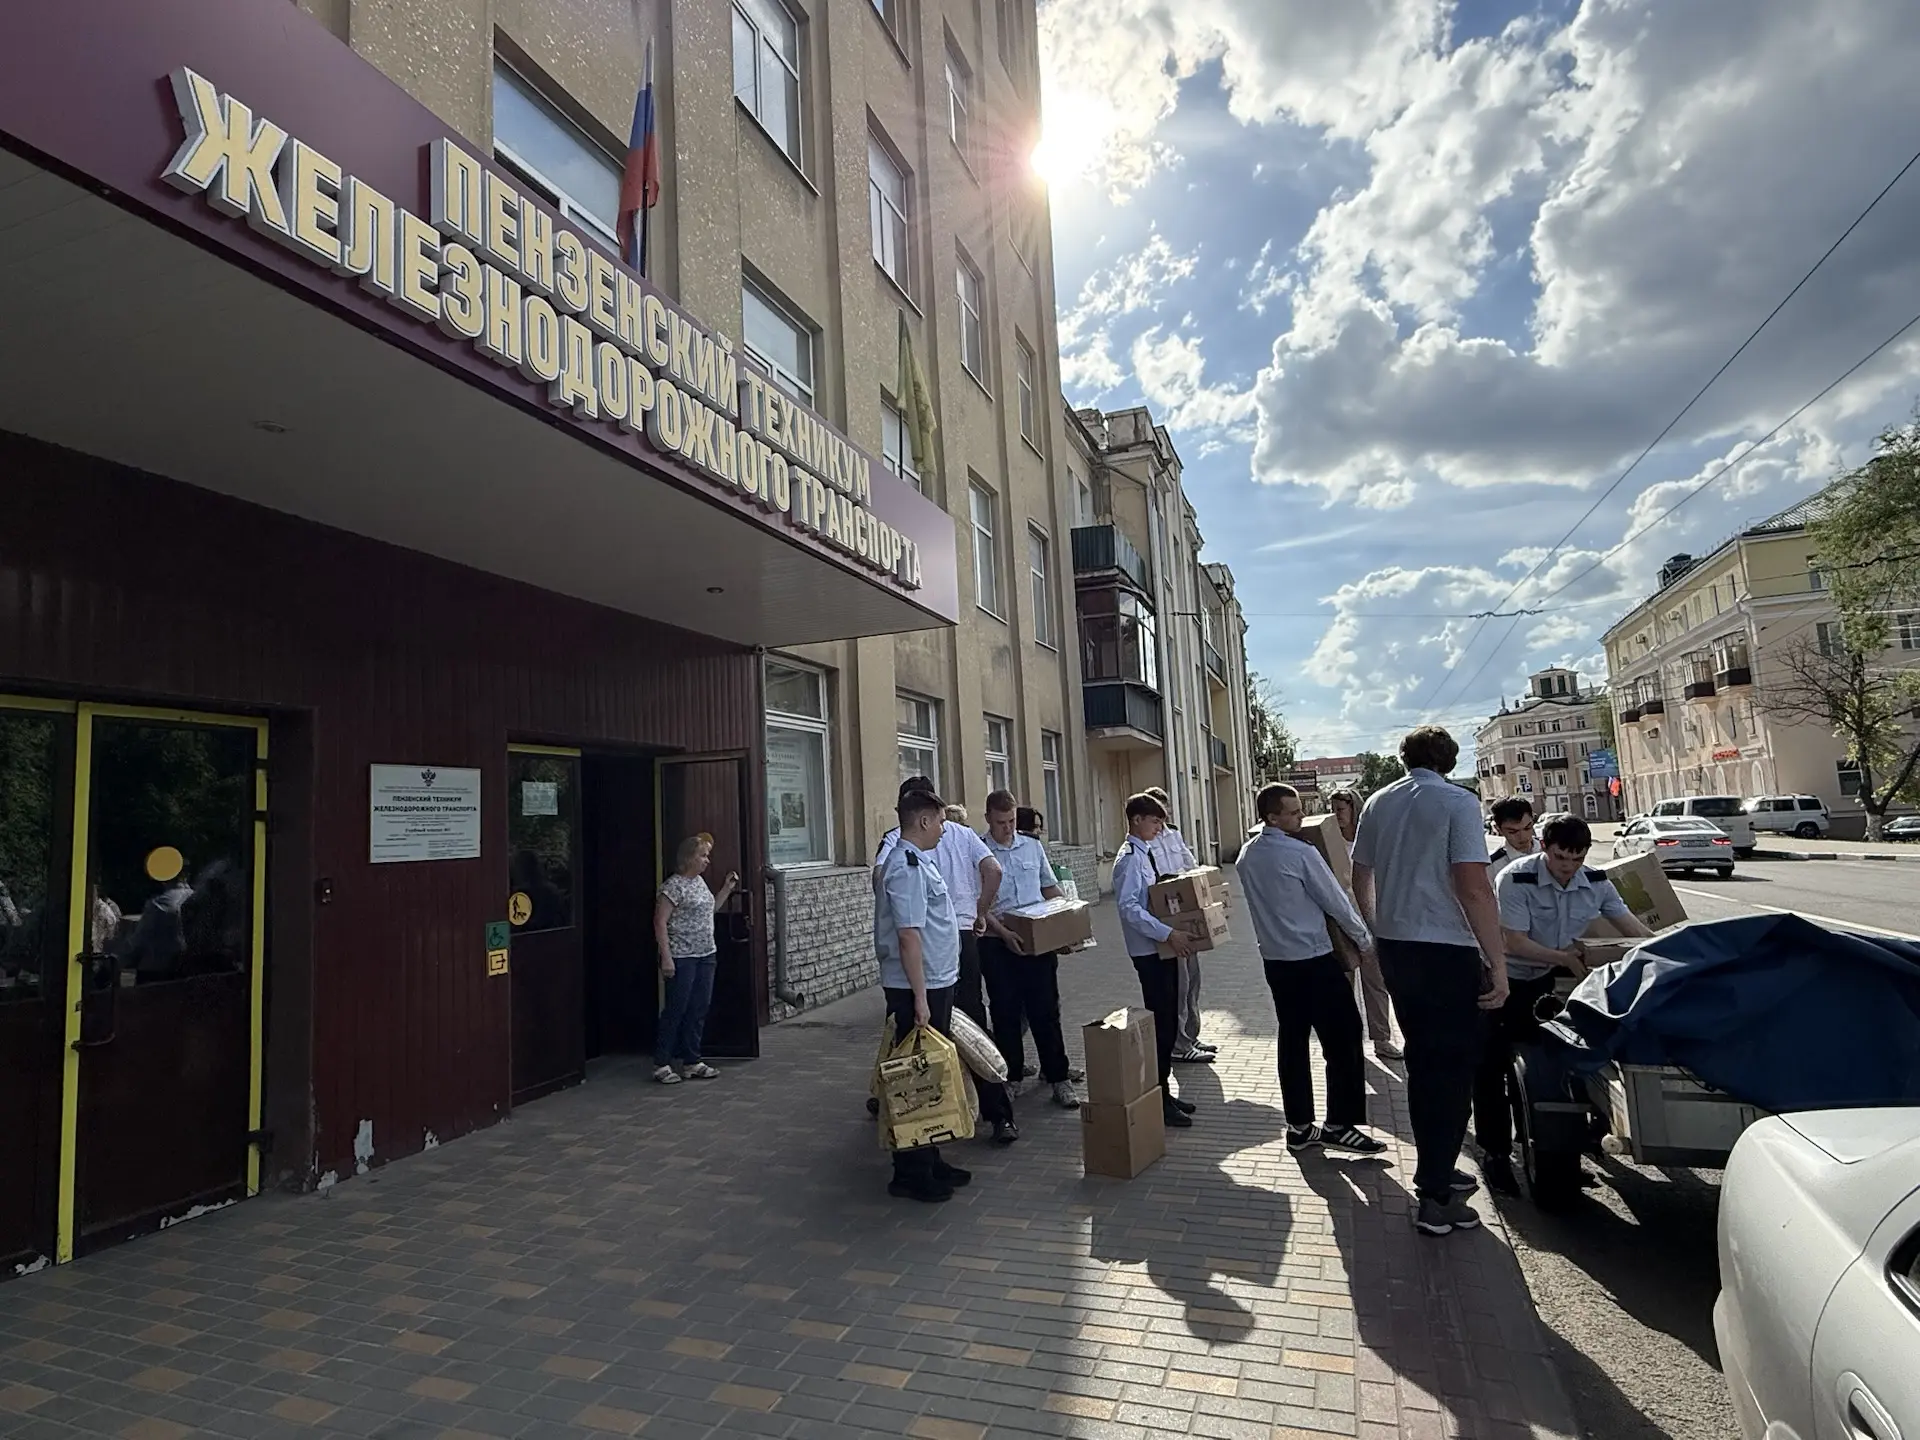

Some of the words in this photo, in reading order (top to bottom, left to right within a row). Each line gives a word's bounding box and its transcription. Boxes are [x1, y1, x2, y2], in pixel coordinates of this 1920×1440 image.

[164, 66, 790, 513] ЖЕЛЕЗНОДОРОЖНОГО
[792, 464, 923, 590] ТРАНСПОРТА
[431, 136, 739, 418] ПЕНЗЕНСКИЙ
[741, 366, 872, 507] ТЕХНИКУМ
[923, 1124, 945, 1133] SONY
